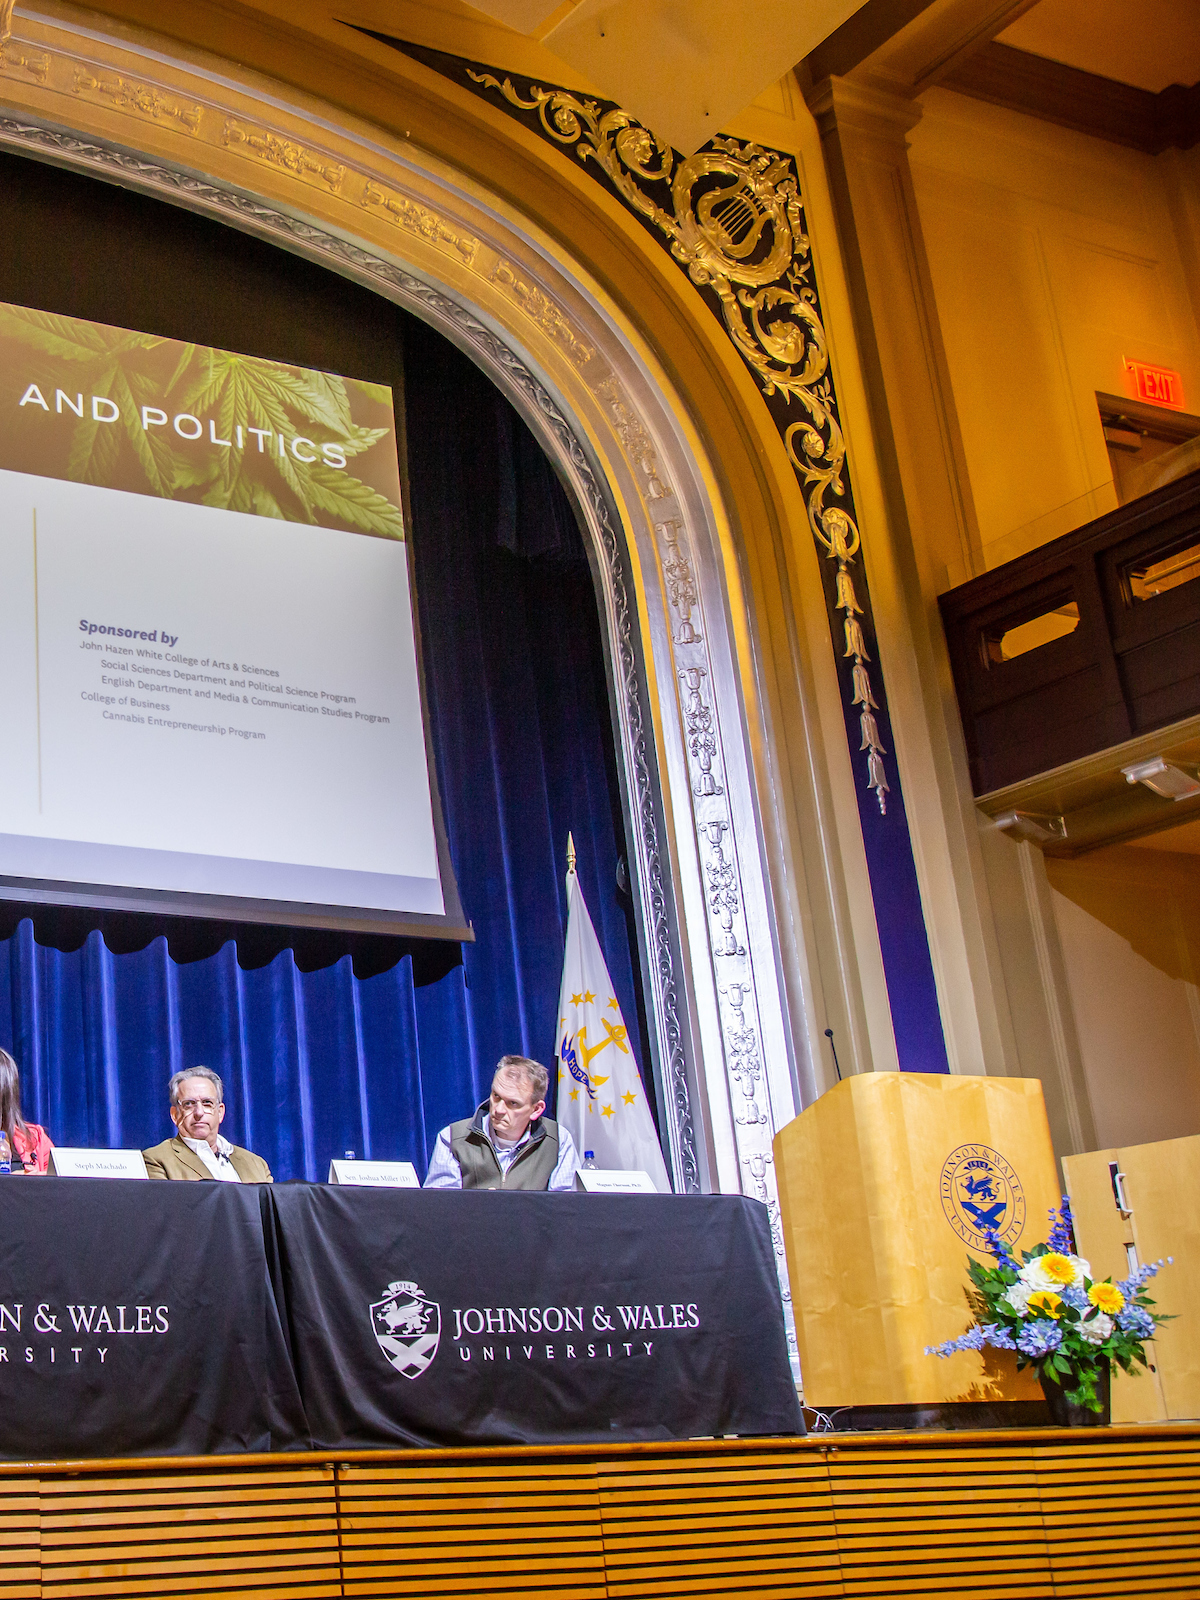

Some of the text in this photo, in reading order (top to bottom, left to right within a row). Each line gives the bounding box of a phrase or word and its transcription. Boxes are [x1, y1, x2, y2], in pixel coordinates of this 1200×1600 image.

[1143, 369, 1174, 402] EXIT
[19, 384, 120, 423] AND
[142, 405, 348, 469] POLITICS
[78, 619, 179, 648] Sponsored by
[79, 641, 280, 678] John Hazen White College of Arts & Sciences
[100, 659, 357, 704] Social Sciences Department and Political Science Program
[80, 691, 171, 711] College of Business
[101, 675, 390, 724] English Department and Media & Communication Studies Program
[102, 710, 266, 740] Cannabis Entrepreneurship Program
[568, 1057, 589, 1084] HOPE
[74, 1163, 95, 1171] Steph
[942, 1146, 1023, 1203] JOHNSON & WALES
[950, 1215, 1022, 1251] UNIVEITY
[33, 1304, 63, 1333] &
[66, 1305, 170, 1335] WALES
[453, 1303, 700, 1340] JOHNSON & WALES
[459, 1342, 654, 1362] UNIVERSITY
